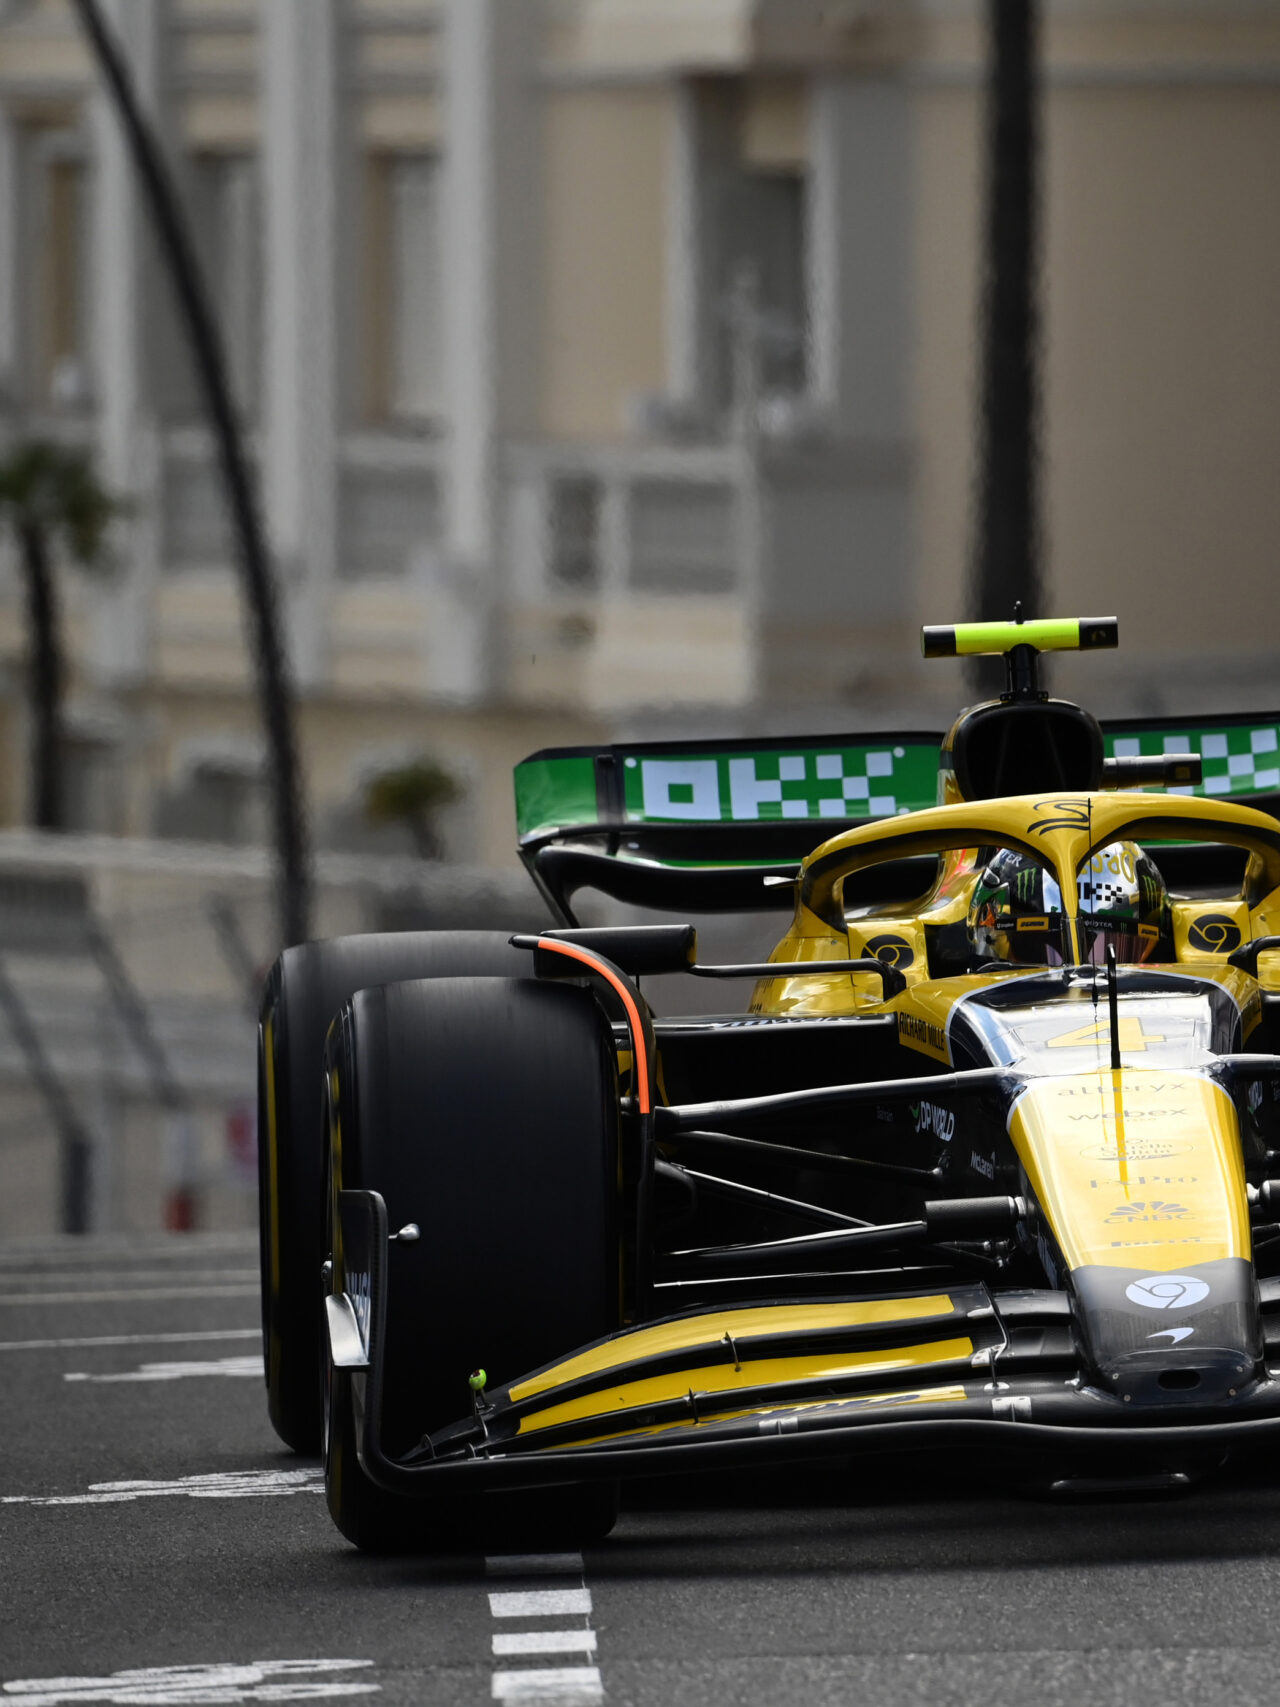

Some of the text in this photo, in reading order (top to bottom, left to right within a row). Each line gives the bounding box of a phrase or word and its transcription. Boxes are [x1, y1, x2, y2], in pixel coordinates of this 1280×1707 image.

[641, 751, 897, 821] OKX
[900, 1011, 945, 1052] RICHARD MILLE
[1045, 1016, 1167, 1052] 4
[1068, 1109, 1187, 1121] webex
[970, 1150, 995, 1180] McLaren
[1103, 1212, 1197, 1224] CNBC
